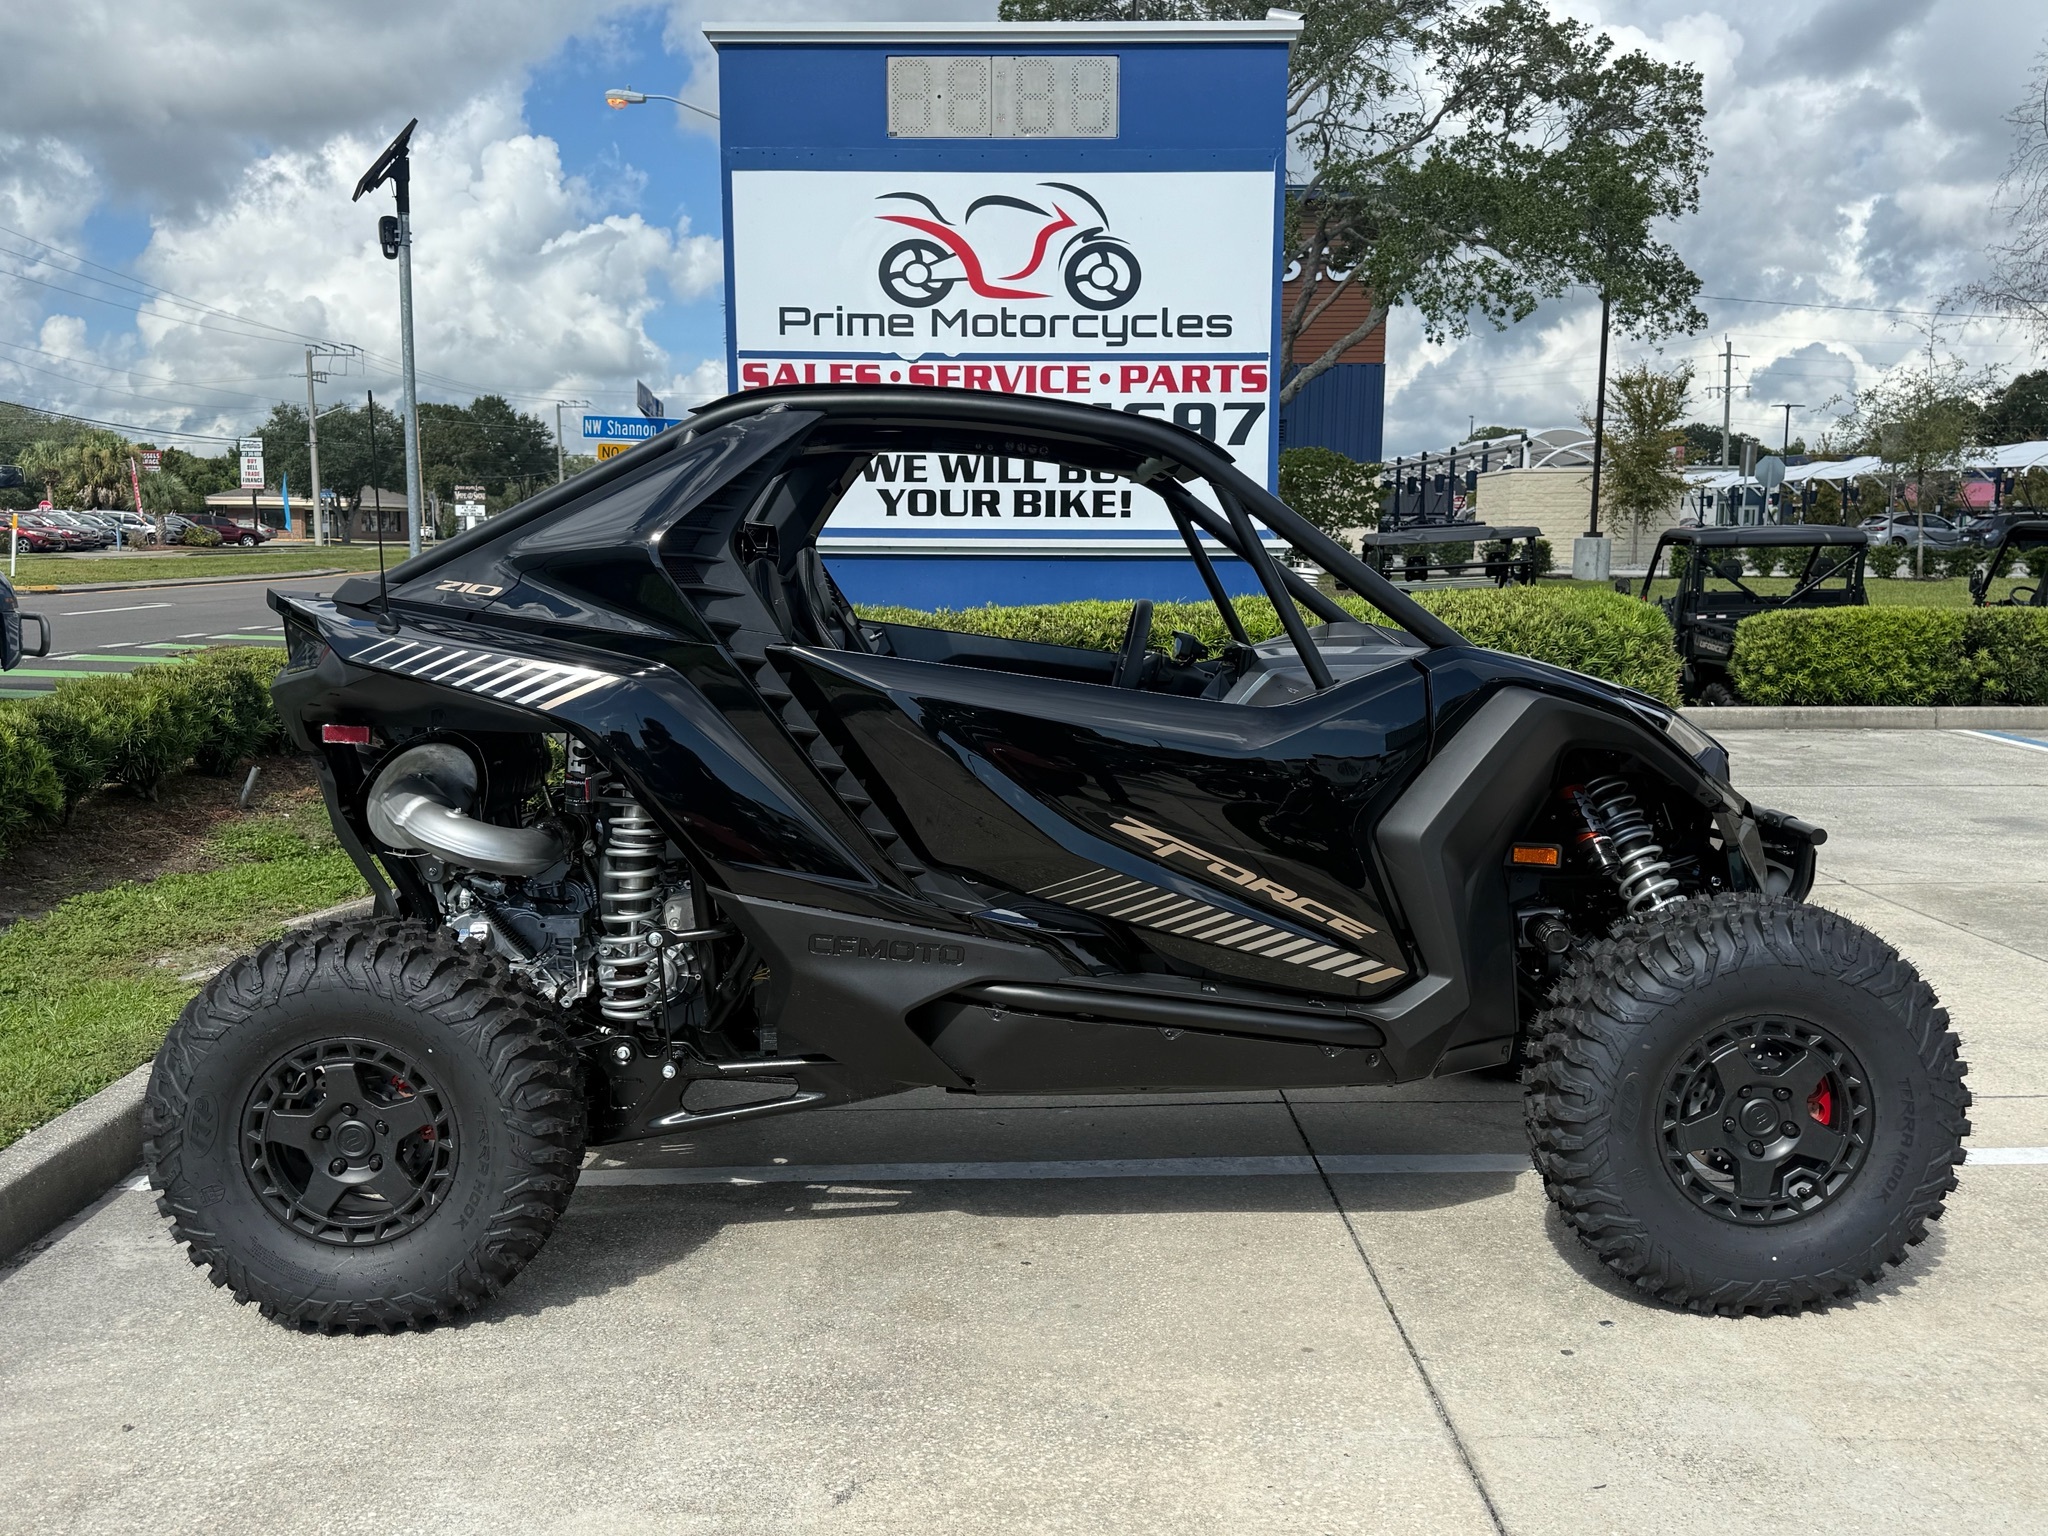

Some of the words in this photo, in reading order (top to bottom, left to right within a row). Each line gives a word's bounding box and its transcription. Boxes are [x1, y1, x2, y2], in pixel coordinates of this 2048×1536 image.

[779, 306, 914, 337] Prime
[931, 307, 1233, 347] Motorcycles
[742, 363, 881, 391] SALES
[908, 364, 1091, 394] SERVICE
[1119, 365, 1268, 394] PARTS
[584, 419, 602, 435] NW
[607, 420, 657, 437] Shannon
[602, 446, 620, 458] NO
[861, 455, 928, 482] WE
[938, 455, 1047, 483] WILL
[876, 489, 1002, 517] YOUR
[1012, 490, 1132, 518] BIKE!
[807, 933, 965, 966] CFMOTO
[1897, 1077, 1917, 1148] TERRA
[1871, 1150, 1910, 1203] HOOK
[452, 1179, 485, 1231] HOOK
